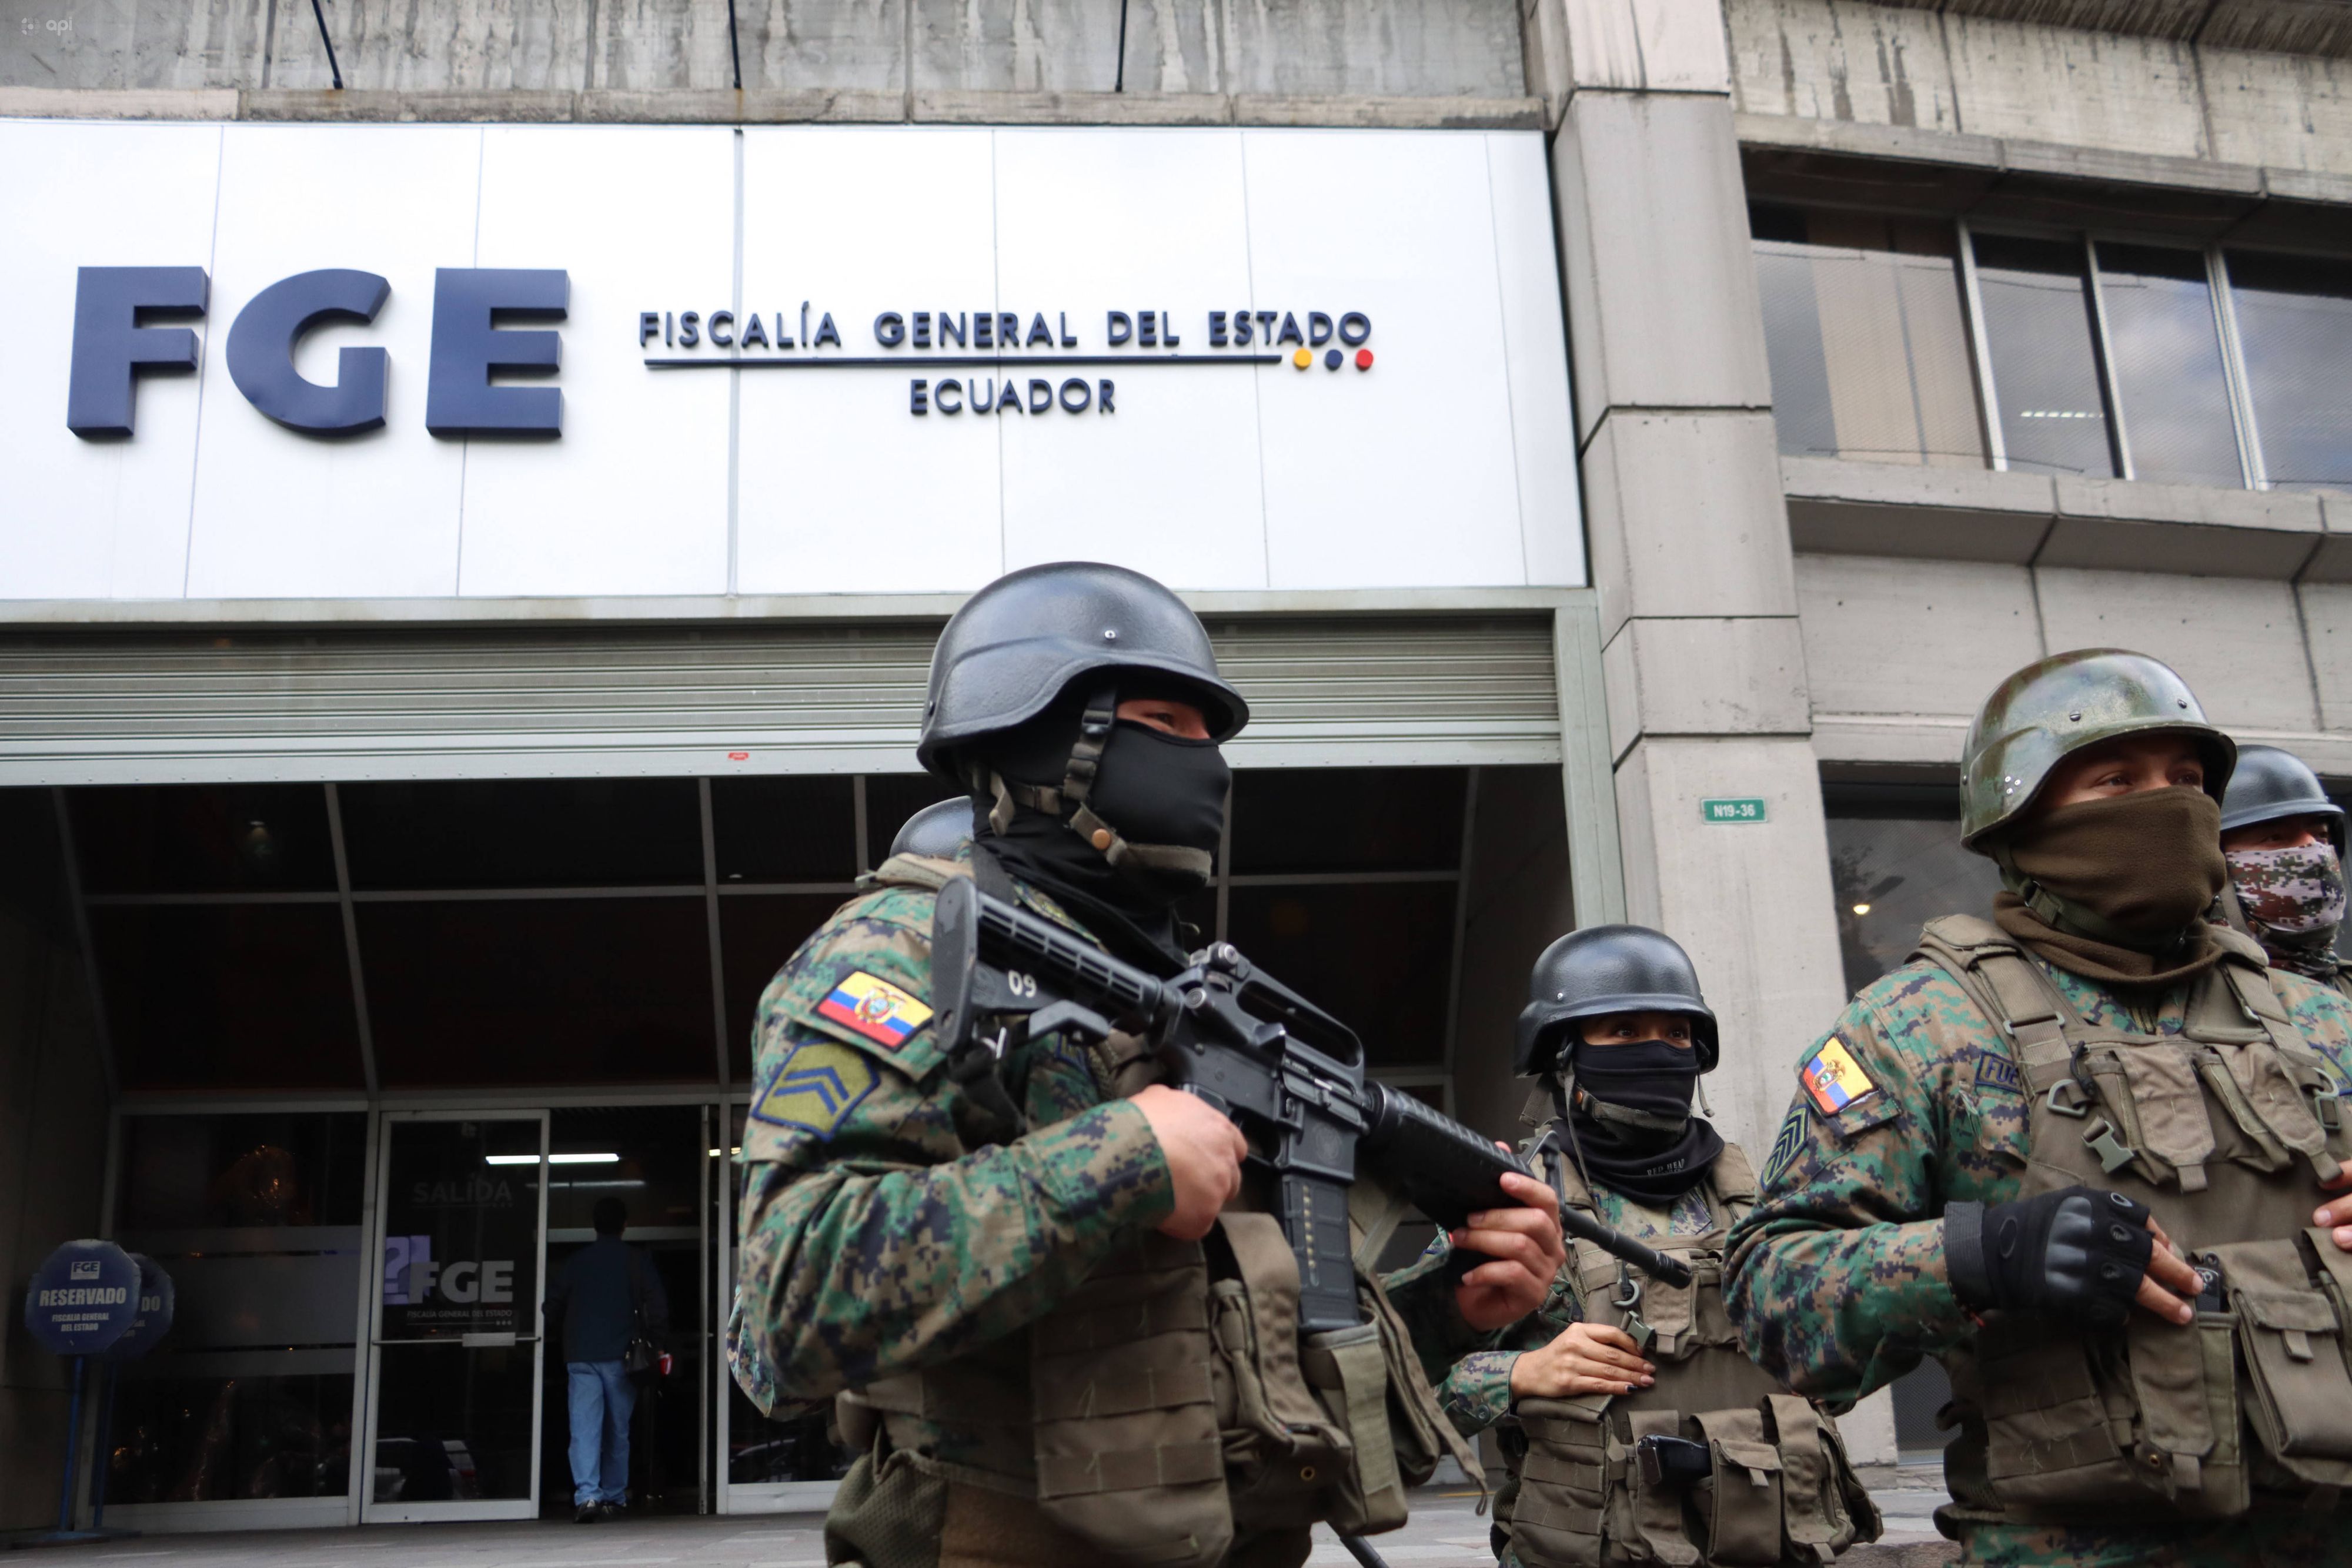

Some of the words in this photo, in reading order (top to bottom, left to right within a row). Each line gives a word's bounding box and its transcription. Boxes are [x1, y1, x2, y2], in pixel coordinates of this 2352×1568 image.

[640, 300, 841, 348] FISCALÍA
[874, 311, 1077, 348] GENERAL
[1107, 311, 1180, 347] DEL
[1208, 310, 1371, 346] ESTADO
[68, 266, 570, 438] FGE
[910, 377, 1115, 414] ECUADOR
[1713, 804, 1755, 817] N19-36
[1008, 969, 1037, 998] 09
[413, 1178, 513, 1203] SALIDA
[73, 1262, 99, 1272] FGE
[409, 1260, 514, 1304] FGE
[39, 1287, 127, 1306] RESERVADO
[74, 1323, 99, 1331] ESTADO
[82, 1312, 109, 1321] GENERAL
